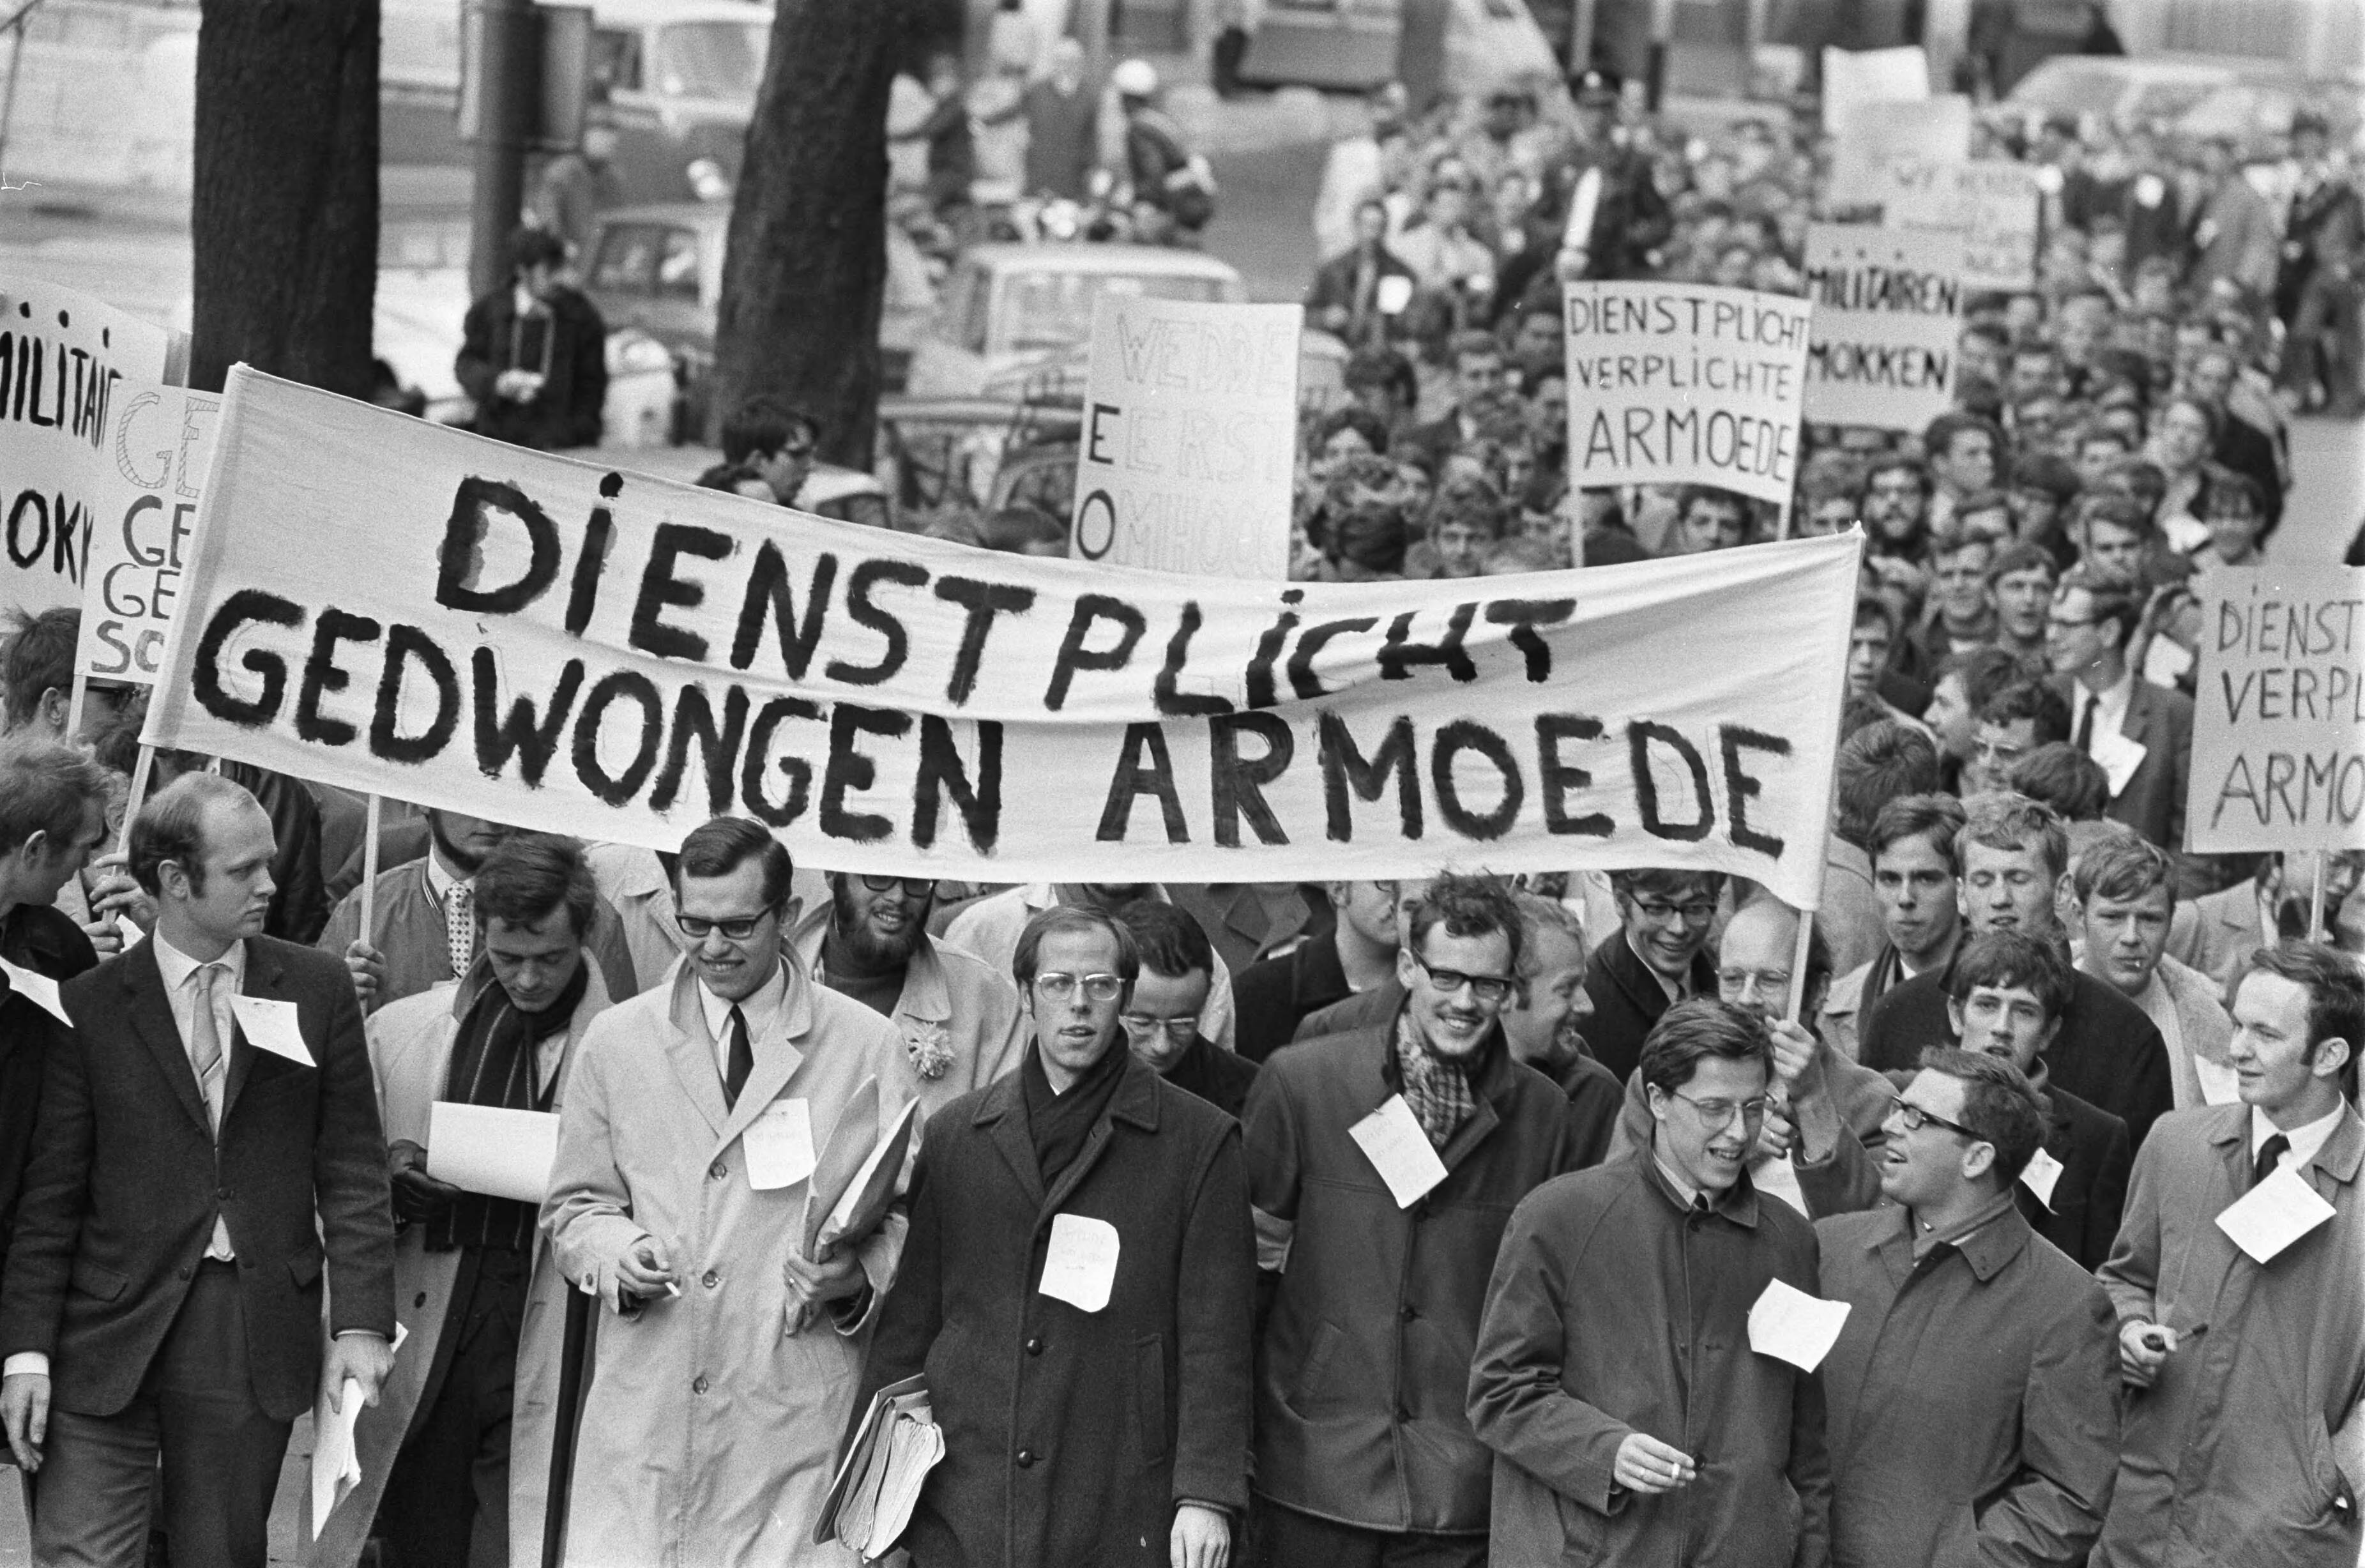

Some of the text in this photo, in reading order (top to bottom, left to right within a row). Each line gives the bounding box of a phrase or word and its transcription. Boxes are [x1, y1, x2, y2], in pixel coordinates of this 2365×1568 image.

[1806, 341, 1948, 392] MOKKEN
[1585, 407, 1791, 482] ARMOEDE
[192, 589, 1791, 859] GEDWONGEN ARMOEDE
